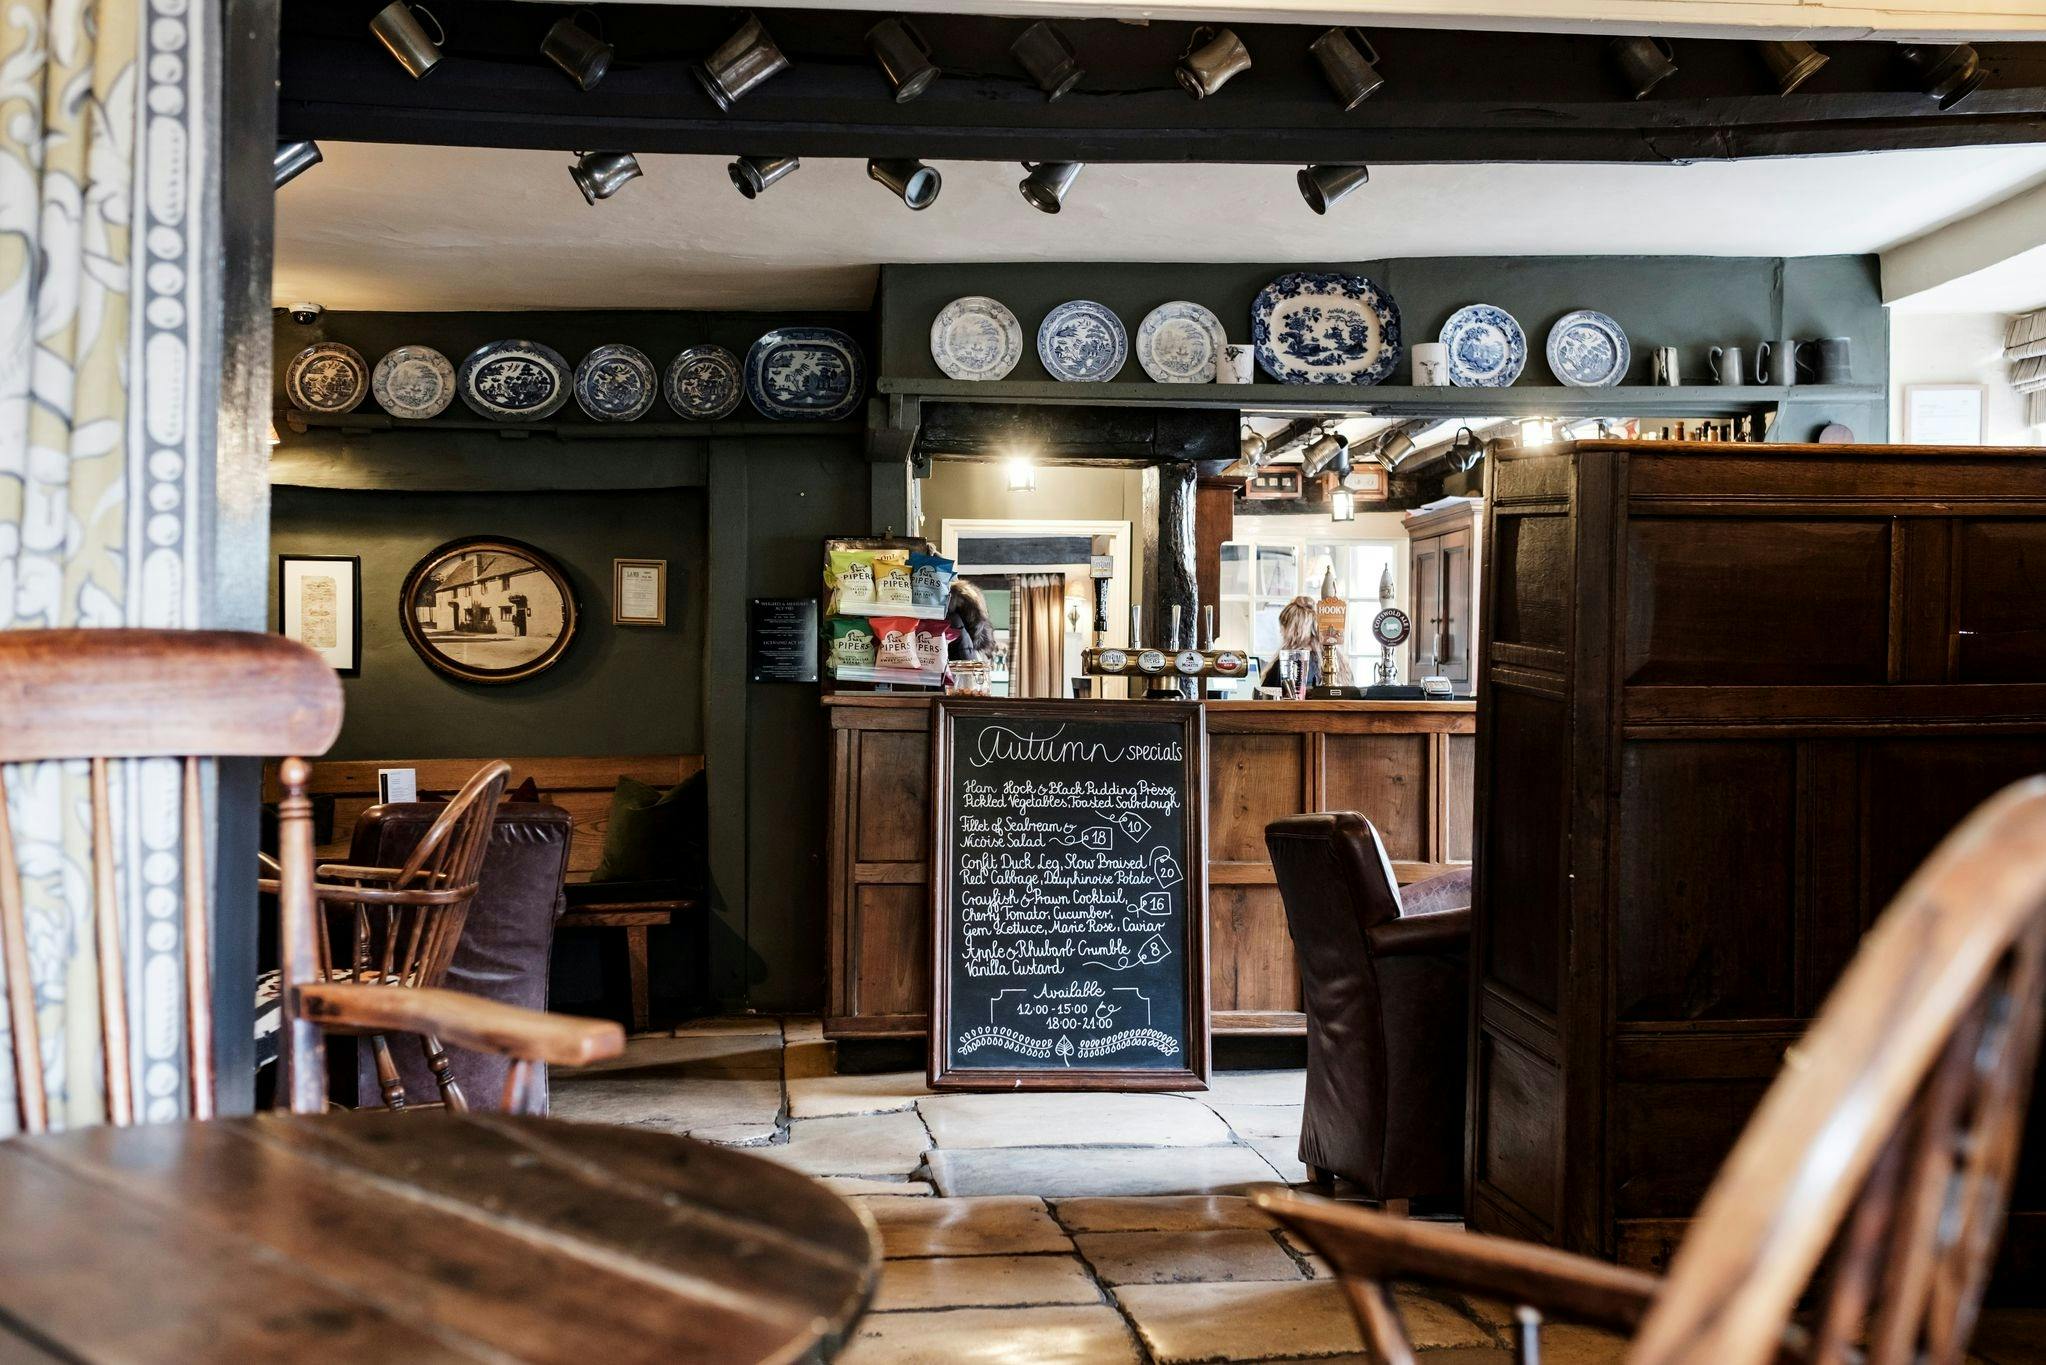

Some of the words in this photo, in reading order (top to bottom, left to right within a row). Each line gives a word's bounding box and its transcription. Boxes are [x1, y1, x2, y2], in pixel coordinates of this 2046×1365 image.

[912, 577, 941, 588] PIPERS
[1318, 606, 1345, 614] HOOKY
[1374, 610, 1401, 628] COTSWOLD
[1400, 616, 1409, 627] ALE
[838, 641, 870, 650] PIPERS
[880, 642, 911, 651] PIPERS
[915, 643, 940, 653] IPERS
[970, 723, 1124, 768] Autumn
[1126, 741, 1183, 762] specials
[963, 779, 998, 794] Ham
[1003, 780, 1036, 794] Hock
[1037, 784, 1048, 796] &
[1048, 781, 1085, 795] Black
[1085, 781, 1137, 801] Pudding
[963, 794, 1007, 808] Pickled
[1067, 795, 1114, 809] Toasted
[1115, 795, 1181, 816] Sourdough
[959, 815, 990, 832] Fillet
[991, 817, 1004, 836] of
[1004, 816, 1063, 833] Seabream
[1127, 821, 1142, 833] 10
[1006, 832, 1047, 848] Salad
[1091, 830, 1107, 845] 18
[961, 851, 998, 876] Confit
[1000, 851, 1036, 869] Duck
[1037, 853, 1063, 878] Leg,
[1064, 853, 1096, 869] Slow
[1096, 852, 1148, 869] Braised
[1160, 867, 1175, 878] 20
[959, 869, 987, 885] Red
[989, 869, 1043, 894] Cabbage,
[1043, 870, 1115, 888] Dauphinoise
[1114, 870, 1155, 885] Potato
[961, 888, 1019, 913] Crayfish
[1032, 887, 1072, 905] Prawn
[1072, 888, 1128, 905] Cocktail,
[1149, 896, 1165, 911] 16
[961, 907, 1000, 930] Cherry
[1000, 905, 1051, 921] Tomato,
[1053, 905, 1114, 920] Cucumber,
[963, 923, 993, 946] Gem
[995, 921, 1048, 936] Lettuce,
[1048, 920, 1086, 934] Marie
[1086, 919, 1120, 933] Rose,
[1122, 917, 1166, 932] Caviar
[962, 940, 1005, 962] Apple
[1015, 938, 1076, 957] Rhubarb
[1077, 938, 1131, 956] Crumble
[1150, 942, 1160, 957] 8
[965, 959, 1011, 977] Vanilla
[1012, 958, 1065, 975] Custard
[1033, 980, 1106, 998] Available
[1017, 1003, 1049, 1015] 12:00
[1057, 1003, 1088, 1014] 15:00
